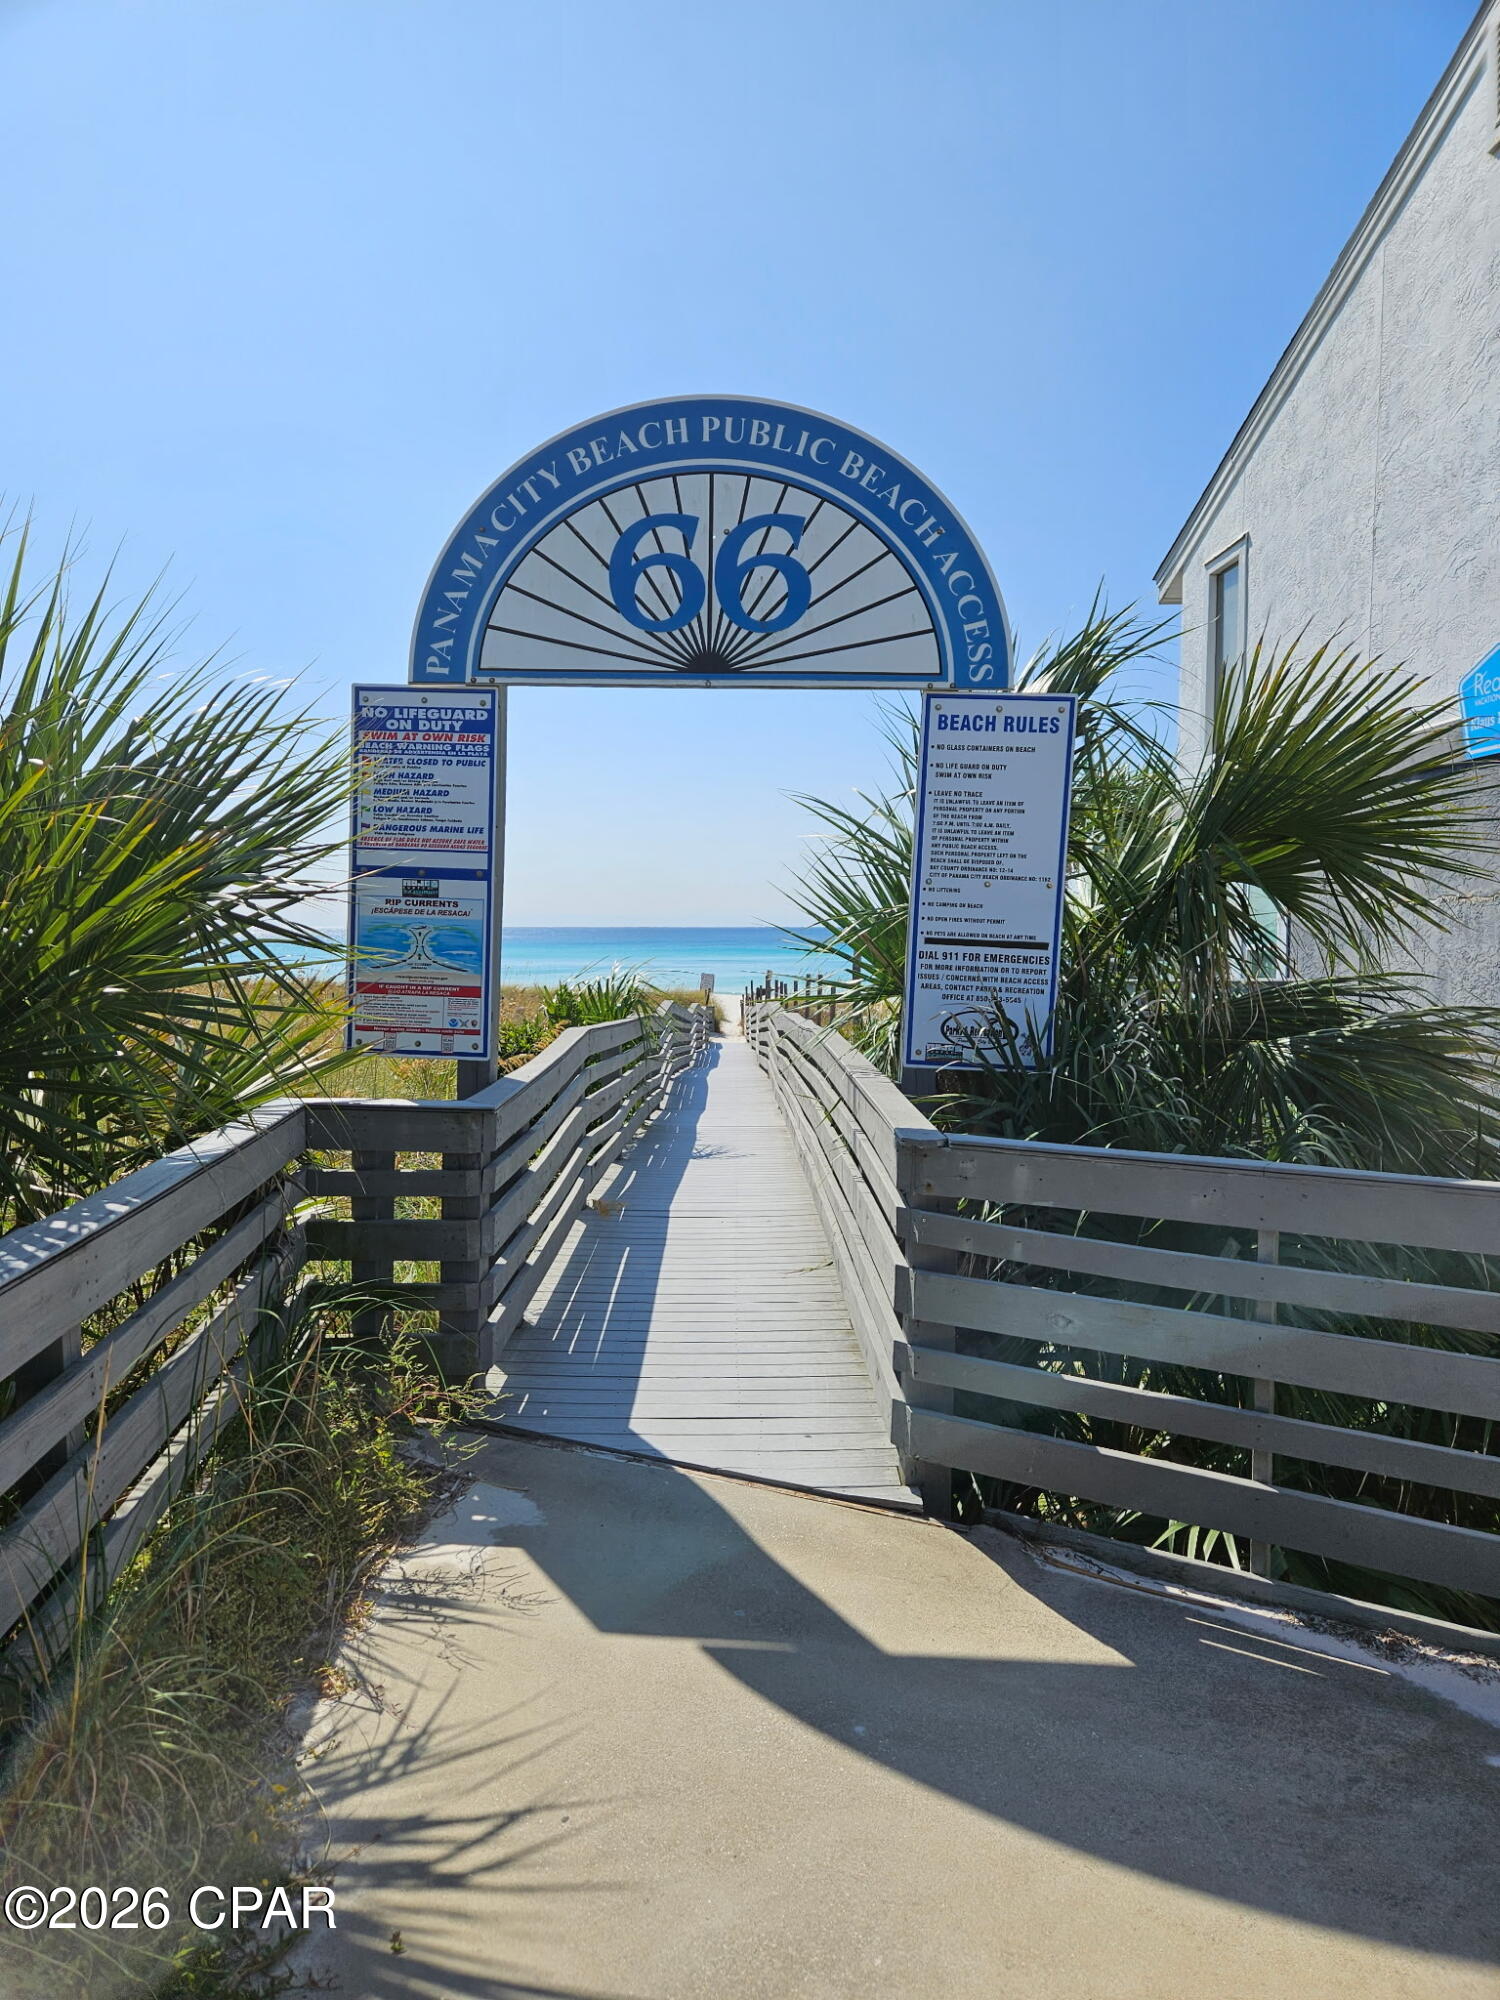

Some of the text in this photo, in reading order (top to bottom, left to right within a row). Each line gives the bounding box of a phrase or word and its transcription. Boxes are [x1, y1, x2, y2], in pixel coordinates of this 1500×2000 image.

[425, 416, 994, 683] PANAMA CITY BEACH PUBLIC BEACH ACCESS
[609, 513, 812, 634] 66
[361, 707, 488, 721] NO LIFEGUARD
[386, 719, 463, 731] ON DUTY
[937, 714, 1061, 734] BEACH RULES
[402, 733, 418, 741] AT
[422, 734, 453, 742] OWN
[457, 735, 486, 743] RISK
[397, 742, 452, 751] WARNING
[456, 744, 490, 752] FLAGS
[407, 758, 438, 766] CLOSED
[456, 759, 486, 768] PUBLIC
[398, 772, 434, 780] HAZARD
[413, 788, 450, 797] HAZARD
[396, 806, 433, 814] HAZARD
[430, 825, 464, 834] MARINE
[467, 826, 485, 835] LIFE
[384, 898, 459, 908] RIP CURRENTS
[437, 909, 471, 917] RESACA!
[918, 950, 1050, 966] DIAL 911 FOR EMERGENCIES
[955, 965, 998, 973] INFORMATION
[1021, 968, 1047, 976] REPORT
[945, 974, 980, 982] CONCERNS
[1000, 976, 1021, 984] BEACH
[1023, 978, 1049, 986] ACCESS
[1005, 987, 1045, 995] RECREATION
[942, 993, 965, 1001] OFFICE
